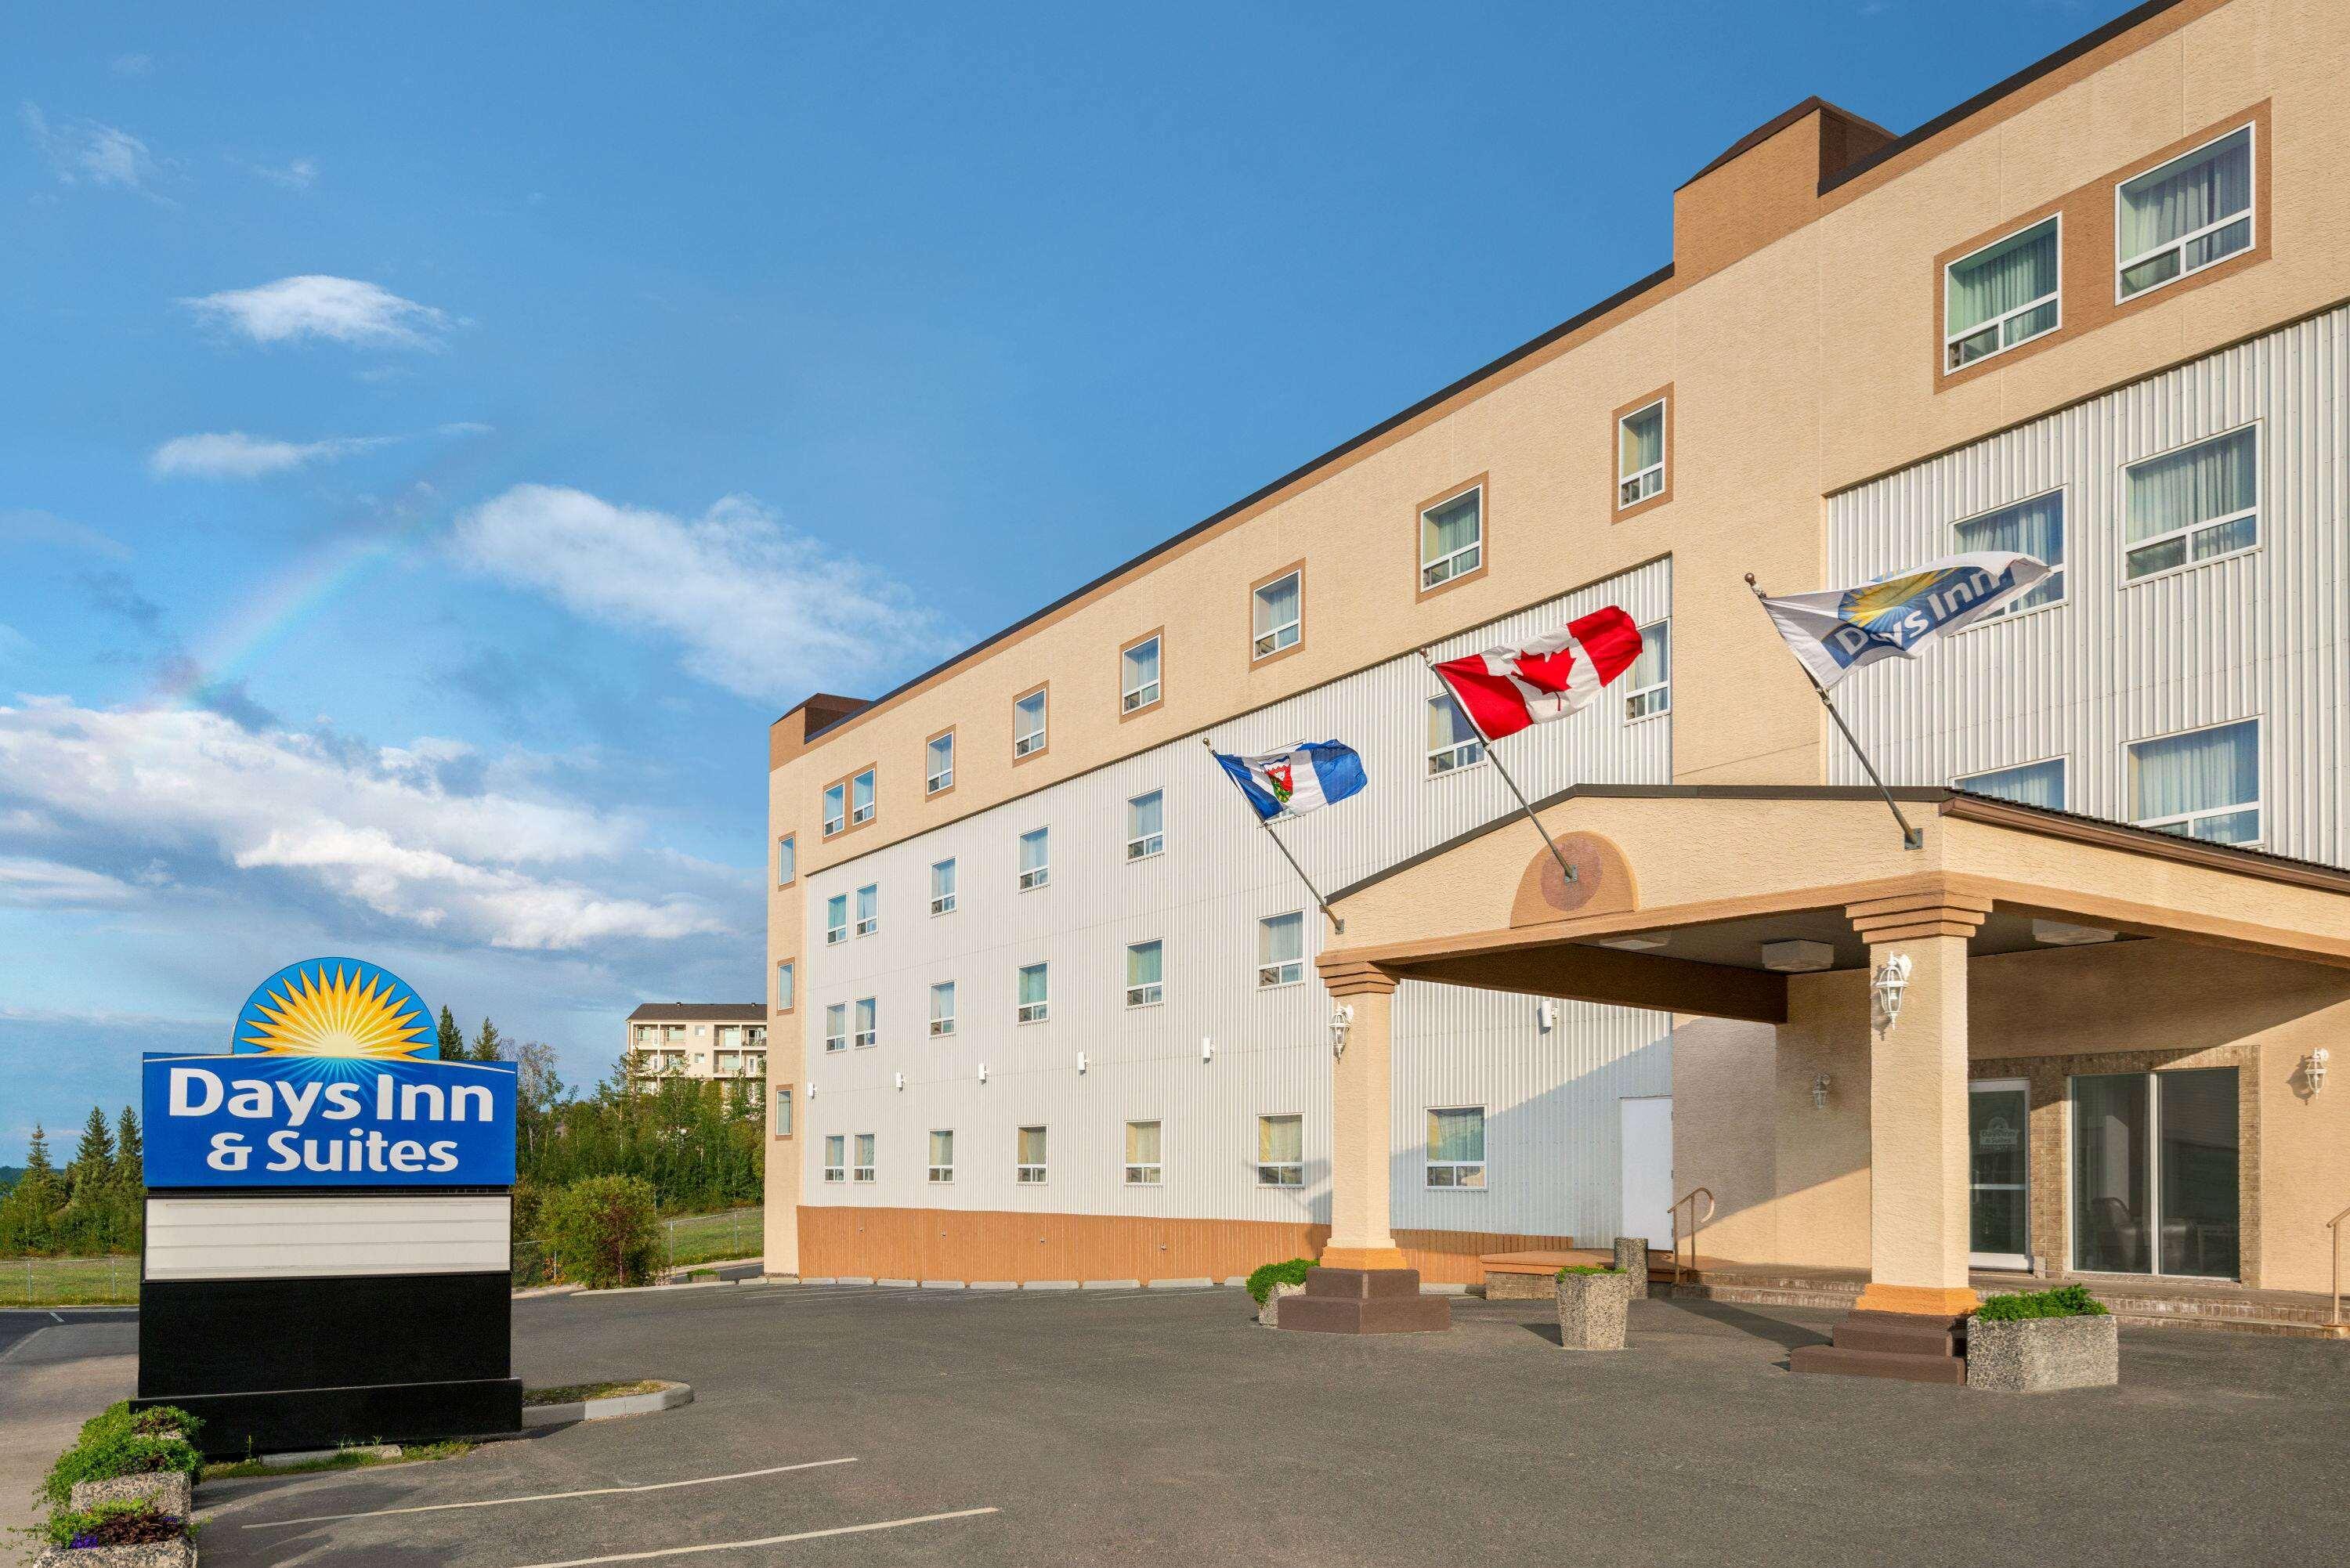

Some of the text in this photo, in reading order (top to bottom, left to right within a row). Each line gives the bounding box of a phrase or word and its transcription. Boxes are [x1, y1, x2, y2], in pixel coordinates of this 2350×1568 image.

[1928, 569, 2001, 621] Inn
[169, 1068, 494, 1126] Days Inn
[207, 1127, 459, 1172] & Suites
